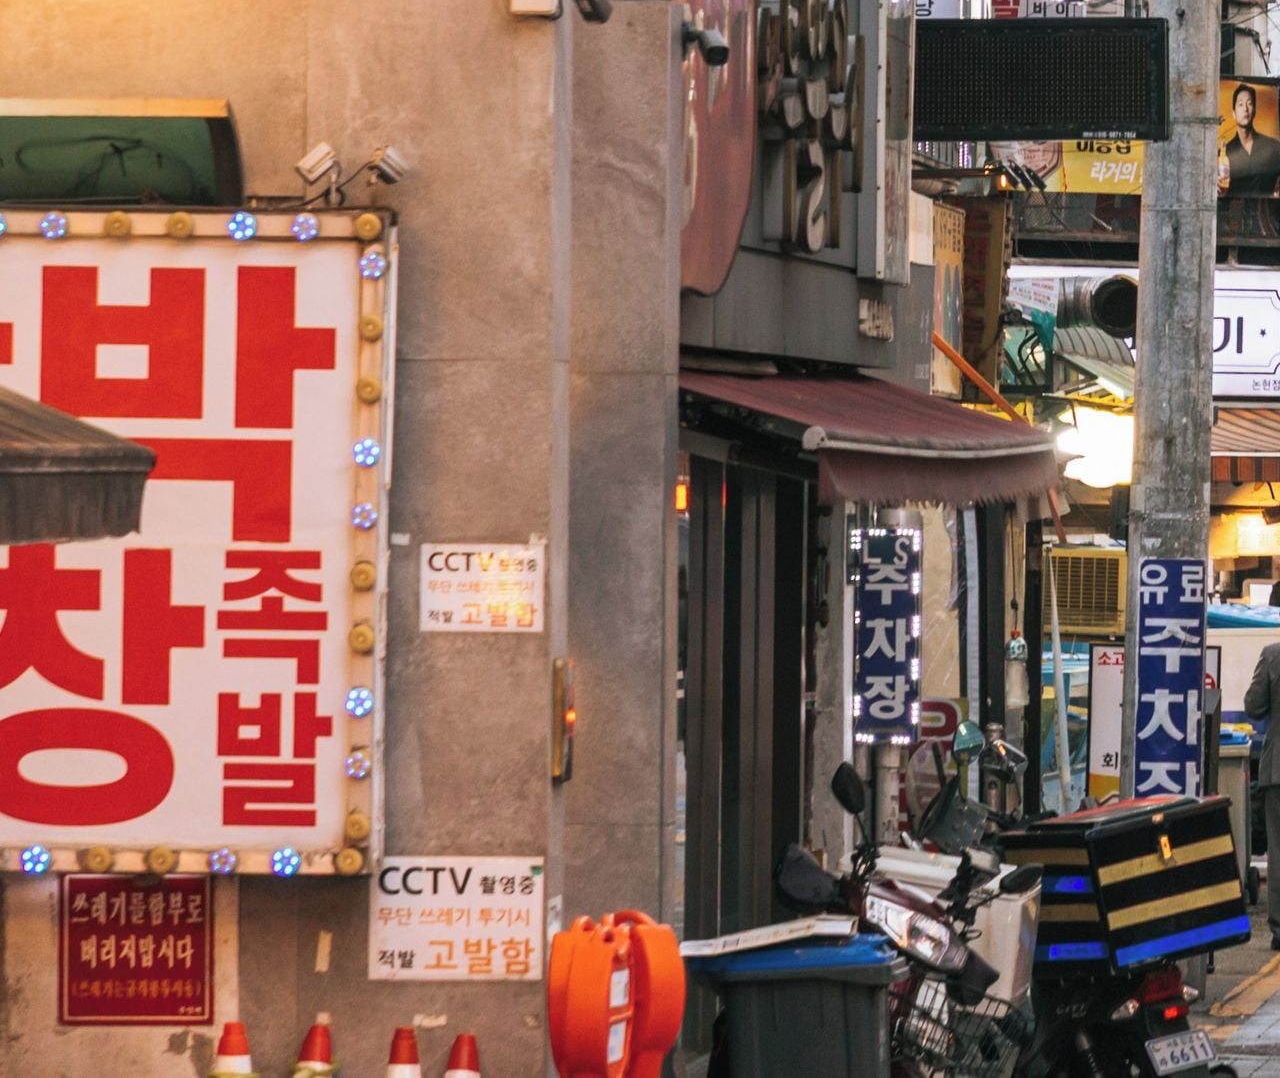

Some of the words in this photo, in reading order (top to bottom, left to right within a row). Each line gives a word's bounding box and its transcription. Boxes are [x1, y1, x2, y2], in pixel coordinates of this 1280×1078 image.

[0, 265, 336, 542] 박
[428, 552, 494, 571] CCTV
[1139, 564, 1203, 604] 유료
[863, 563, 909, 720] 주차장
[217, 550, 333, 826] 족발
[378, 866, 473, 895] CCTV
[479, 866, 536, 895] 촬영중
[377, 907, 412, 927] 무단
[418, 906, 471, 927] 쓰레기
[477, 906, 531, 926] 투기시
[378, 948, 416, 968] 적발
[424, 937, 535, 974] 고발함
